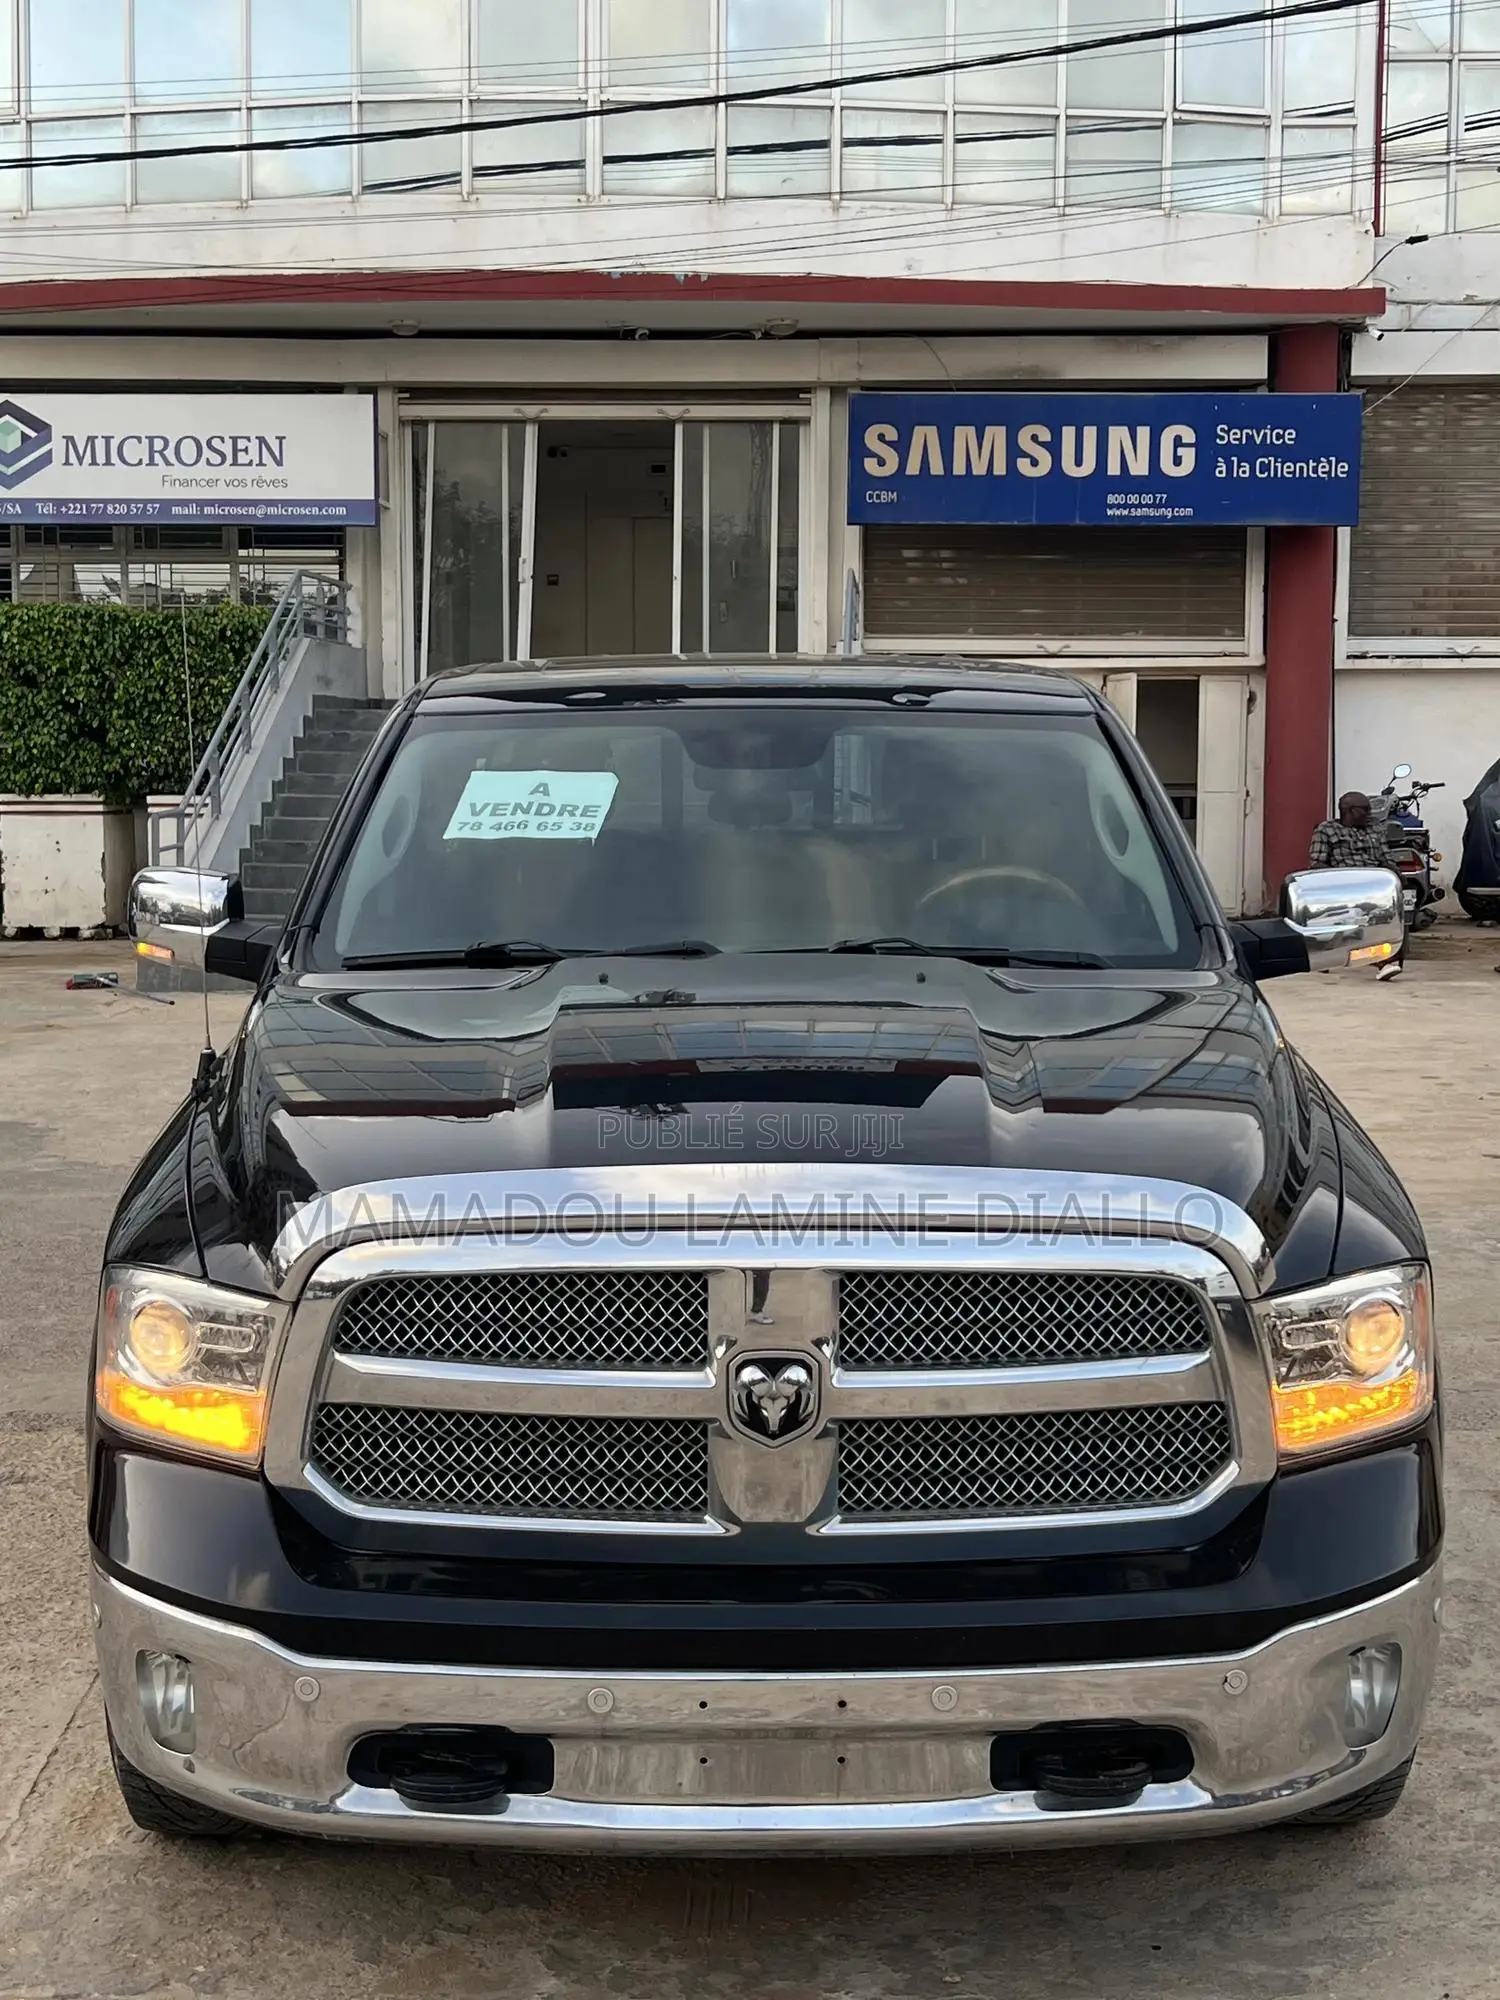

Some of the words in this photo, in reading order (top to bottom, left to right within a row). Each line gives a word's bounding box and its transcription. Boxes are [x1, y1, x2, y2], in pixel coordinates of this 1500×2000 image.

[1216, 424, 1297, 445] Service
[62, 435, 286, 467] MICROSEN
[864, 424, 1197, 478] SAMSUNG
[1215, 457, 1227, 478] à
[1231, 457, 1250, 478] la
[1255, 457, 1349, 480] Clientèle
[161, 474, 221, 488] Financer
[223, 477, 248, 488] vos
[251, 475, 288, 489] rêves
[866, 491, 897, 503] CCBM
[1127, 494, 1139, 504] 00
[1140, 494, 1153, 504] 00
[1155, 494, 1168, 504] 77
[36, 502, 57, 514] Tél:
[60, 504, 87, 515] +221
[91, 503, 103, 514] 77
[106, 503, 127, 514] 820
[129, 503, 143, 514] 57
[146, 503, 160, 515] 57
[171, 503, 200, 516] mail:
[203, 504, 347, 518] microsen@microsen.com
[1106, 507, 1194, 518] www.samsung.com
[528, 782, 551, 797] A
[469, 801, 602, 819] VENDRE
[457, 821, 483, 832] 78
[489, 819, 530, 833] 466
[536, 821, 564, 833] 65
[569, 821, 597, 833] 38
